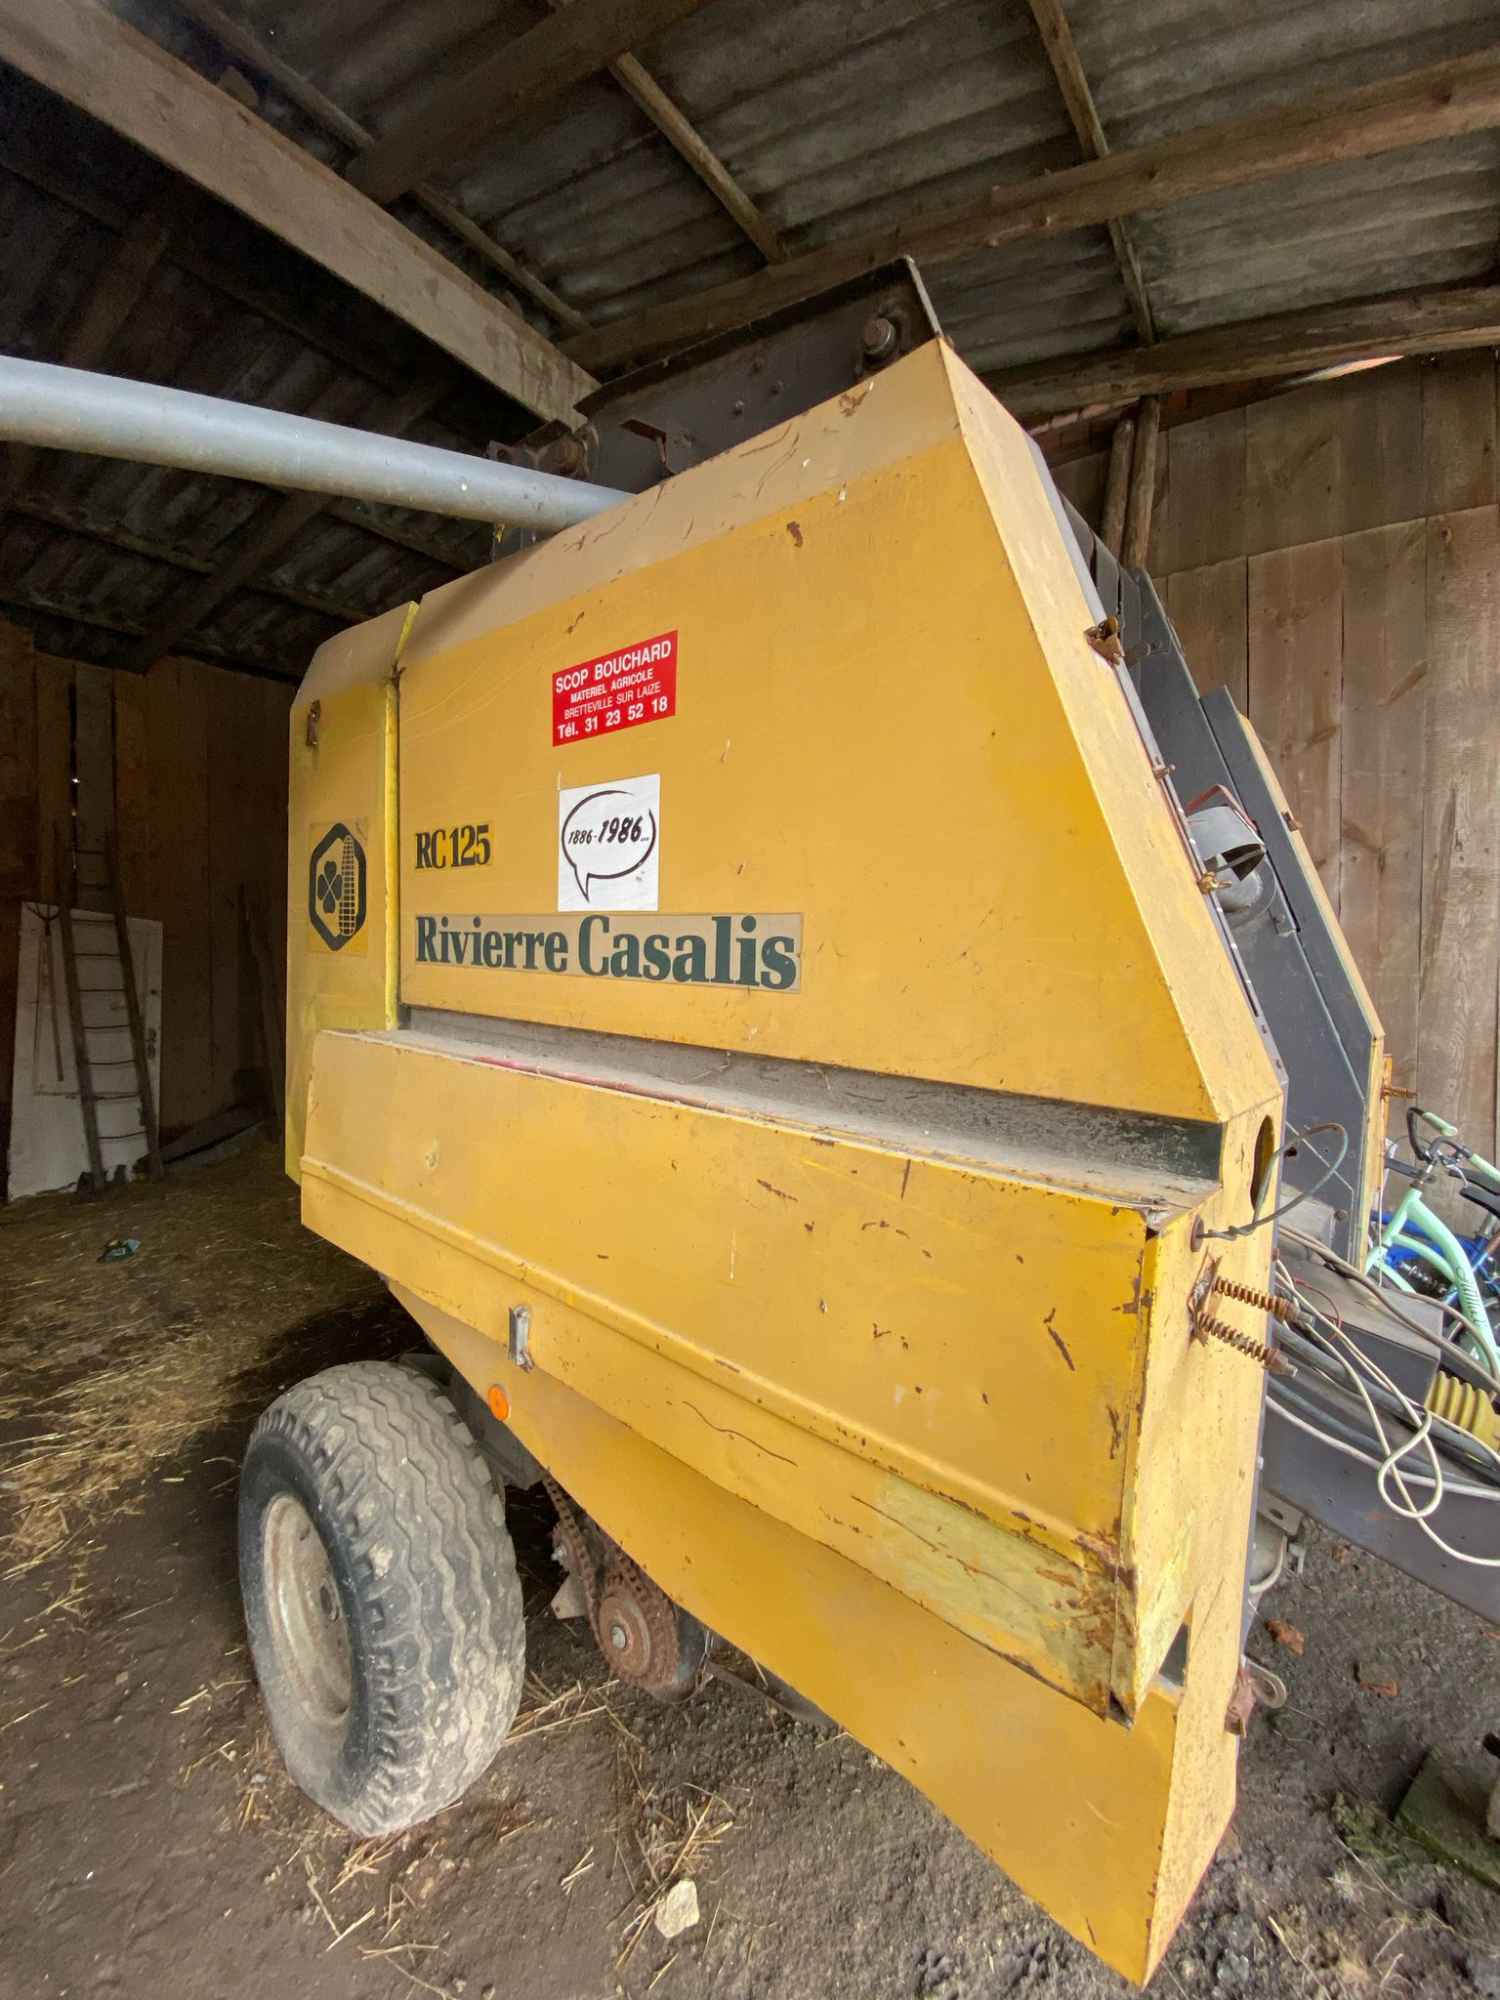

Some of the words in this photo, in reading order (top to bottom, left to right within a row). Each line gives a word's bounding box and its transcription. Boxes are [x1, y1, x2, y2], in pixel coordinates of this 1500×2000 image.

[555, 668, 589, 693] SCOP
[594, 640, 671, 680] BOUCHARD
[570, 683, 607, 703] MATERIEL
[611, 668, 654, 690] AGRICOLE
[616, 690, 634, 704] SUR
[637, 681, 661, 698] LAIZE
[558, 722, 579, 739] Tél.
[585, 716, 598, 732] 31
[606, 709, 621, 727] 23
[628, 702, 644, 720] 52
[652, 696, 668, 713] 18
[416, 915, 568, 973] Rivierre
[578, 914, 796, 990] Casalis
